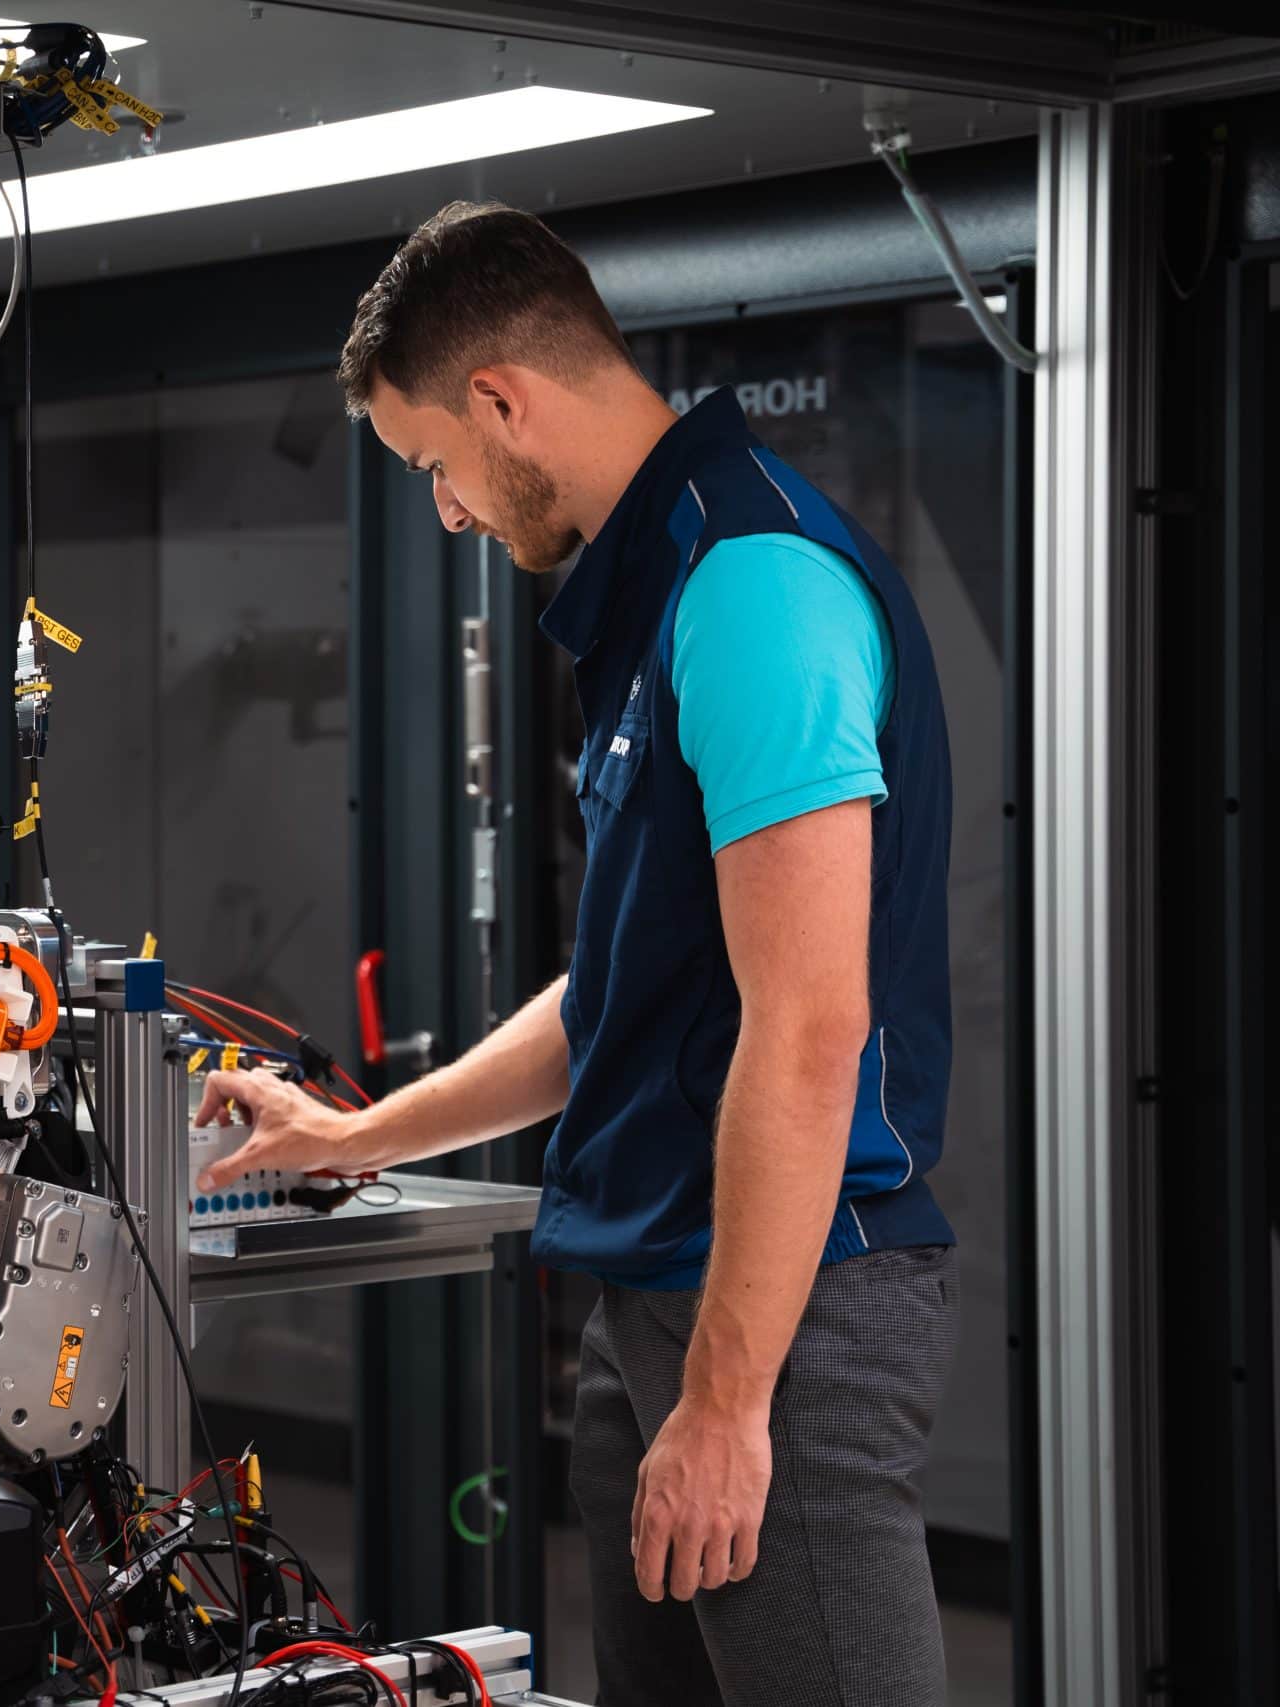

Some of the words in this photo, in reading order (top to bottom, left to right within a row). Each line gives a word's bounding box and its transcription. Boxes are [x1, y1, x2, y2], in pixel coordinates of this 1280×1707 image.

[68, 87, 89, 107] CAN
[114, 92, 138, 111] CAN
[57, 628, 80, 650] GES
